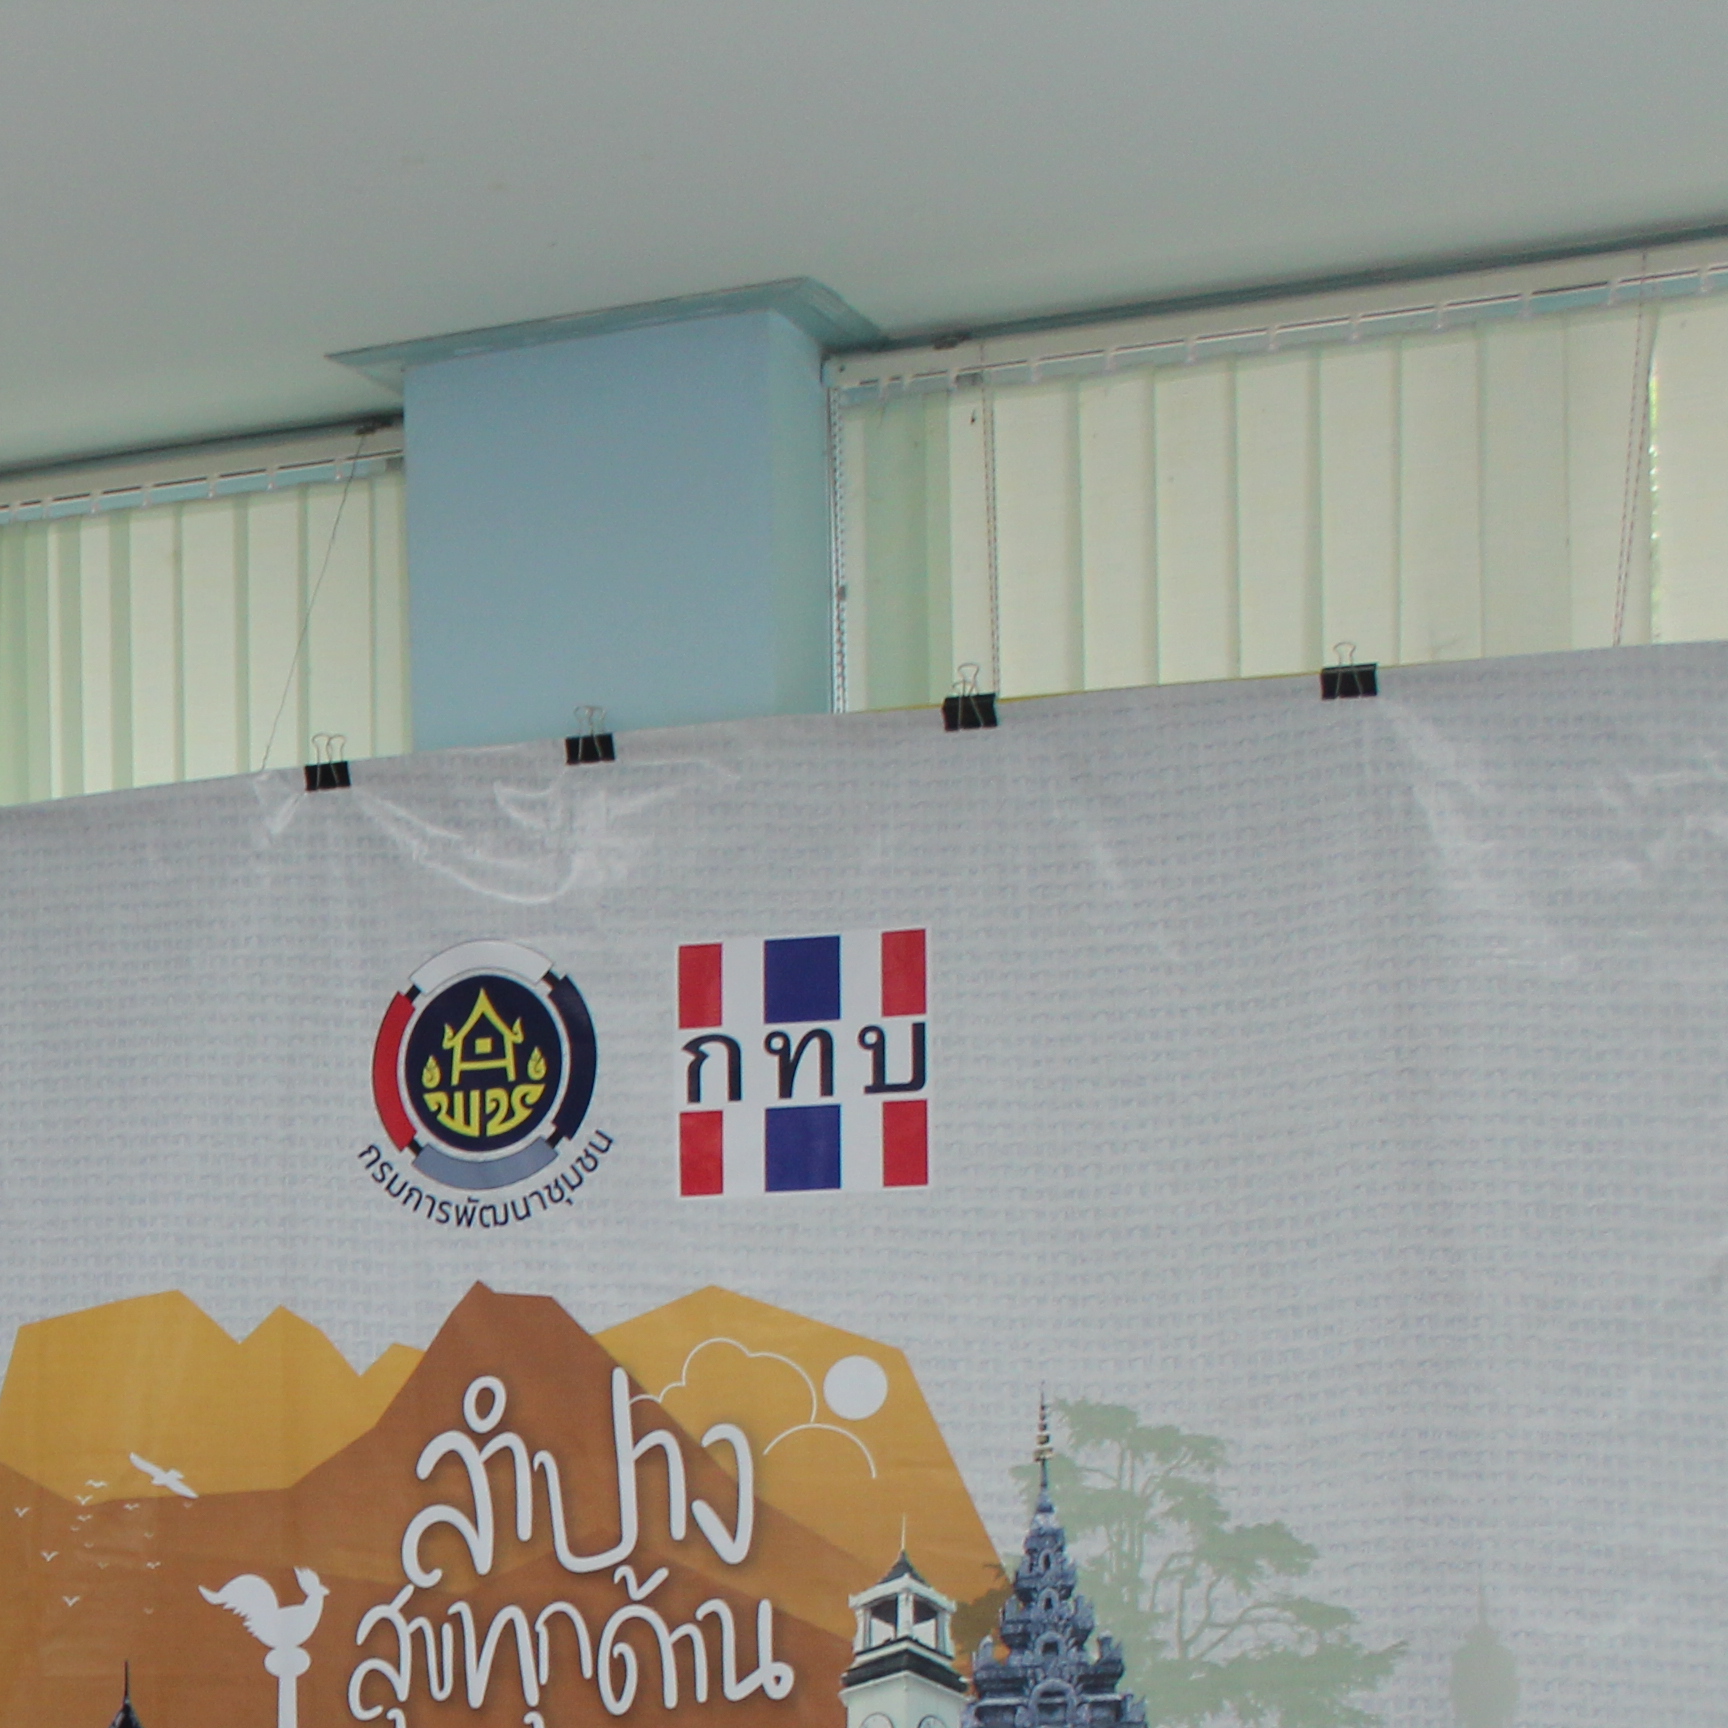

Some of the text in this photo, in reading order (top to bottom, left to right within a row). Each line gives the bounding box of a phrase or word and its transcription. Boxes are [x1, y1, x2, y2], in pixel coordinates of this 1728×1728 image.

[680, 1021, 928, 1103] กทบ
[358, 1129, 613, 1228] กรมการพัฒนาชุมชน
[402, 1366, 754, 1588] ลำปาง
